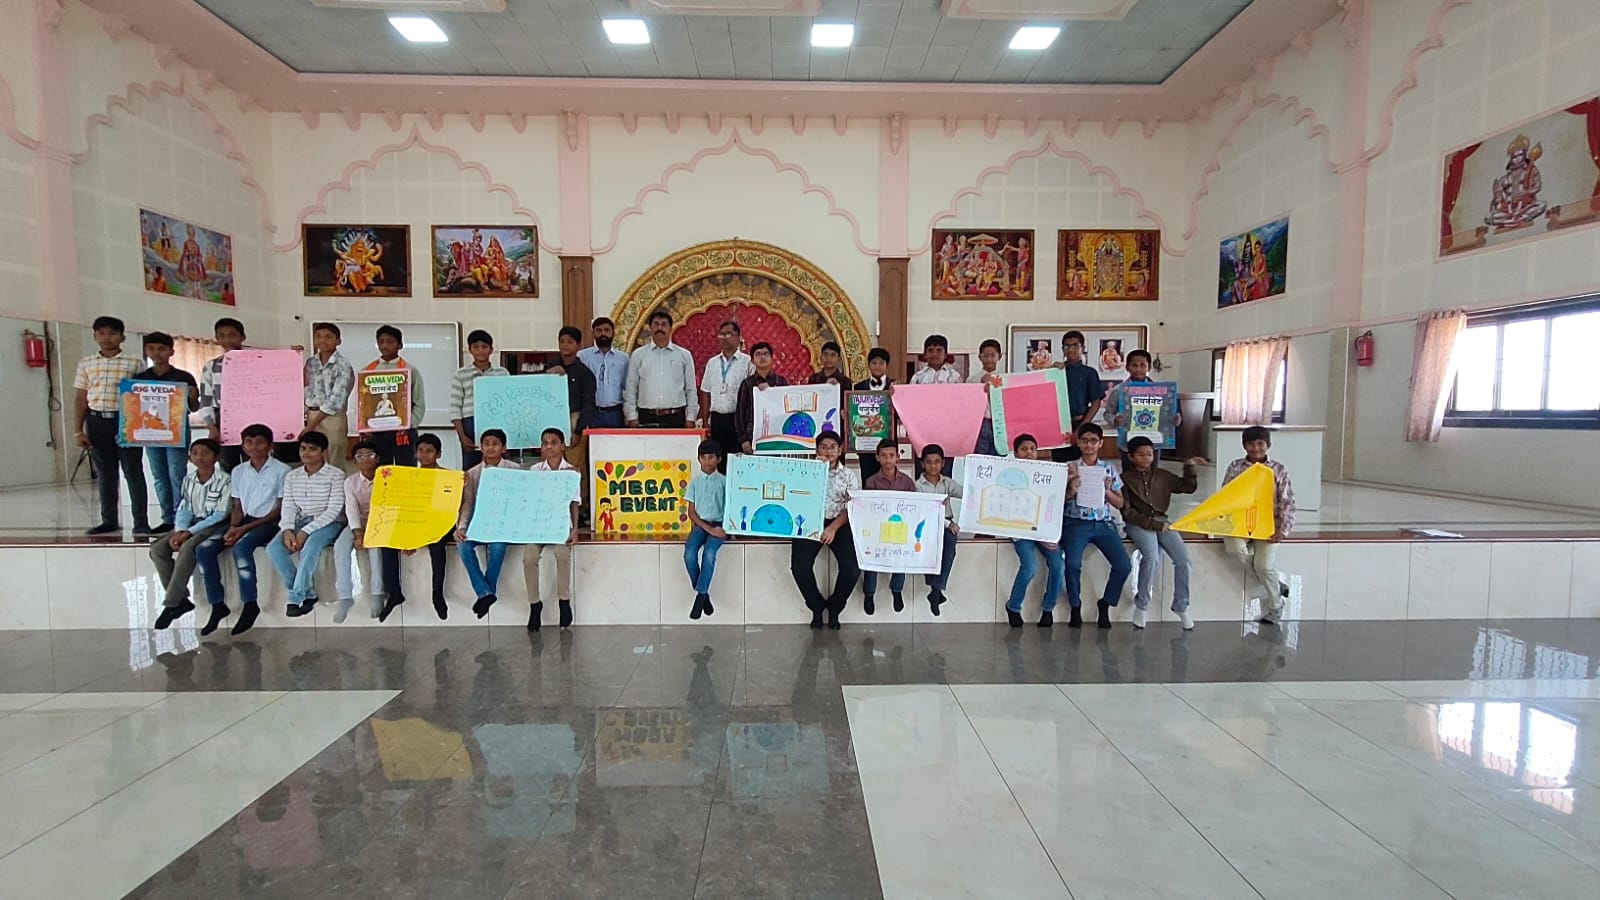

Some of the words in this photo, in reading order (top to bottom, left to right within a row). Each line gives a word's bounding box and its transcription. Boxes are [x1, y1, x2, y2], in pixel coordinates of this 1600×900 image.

[367, 376, 385, 384] SAMA
[387, 375, 404, 383] VEDA
[133, 385, 149, 393] RIG
[609, 479, 674, 495] MEGA
[620, 496, 678, 513] EVENT
